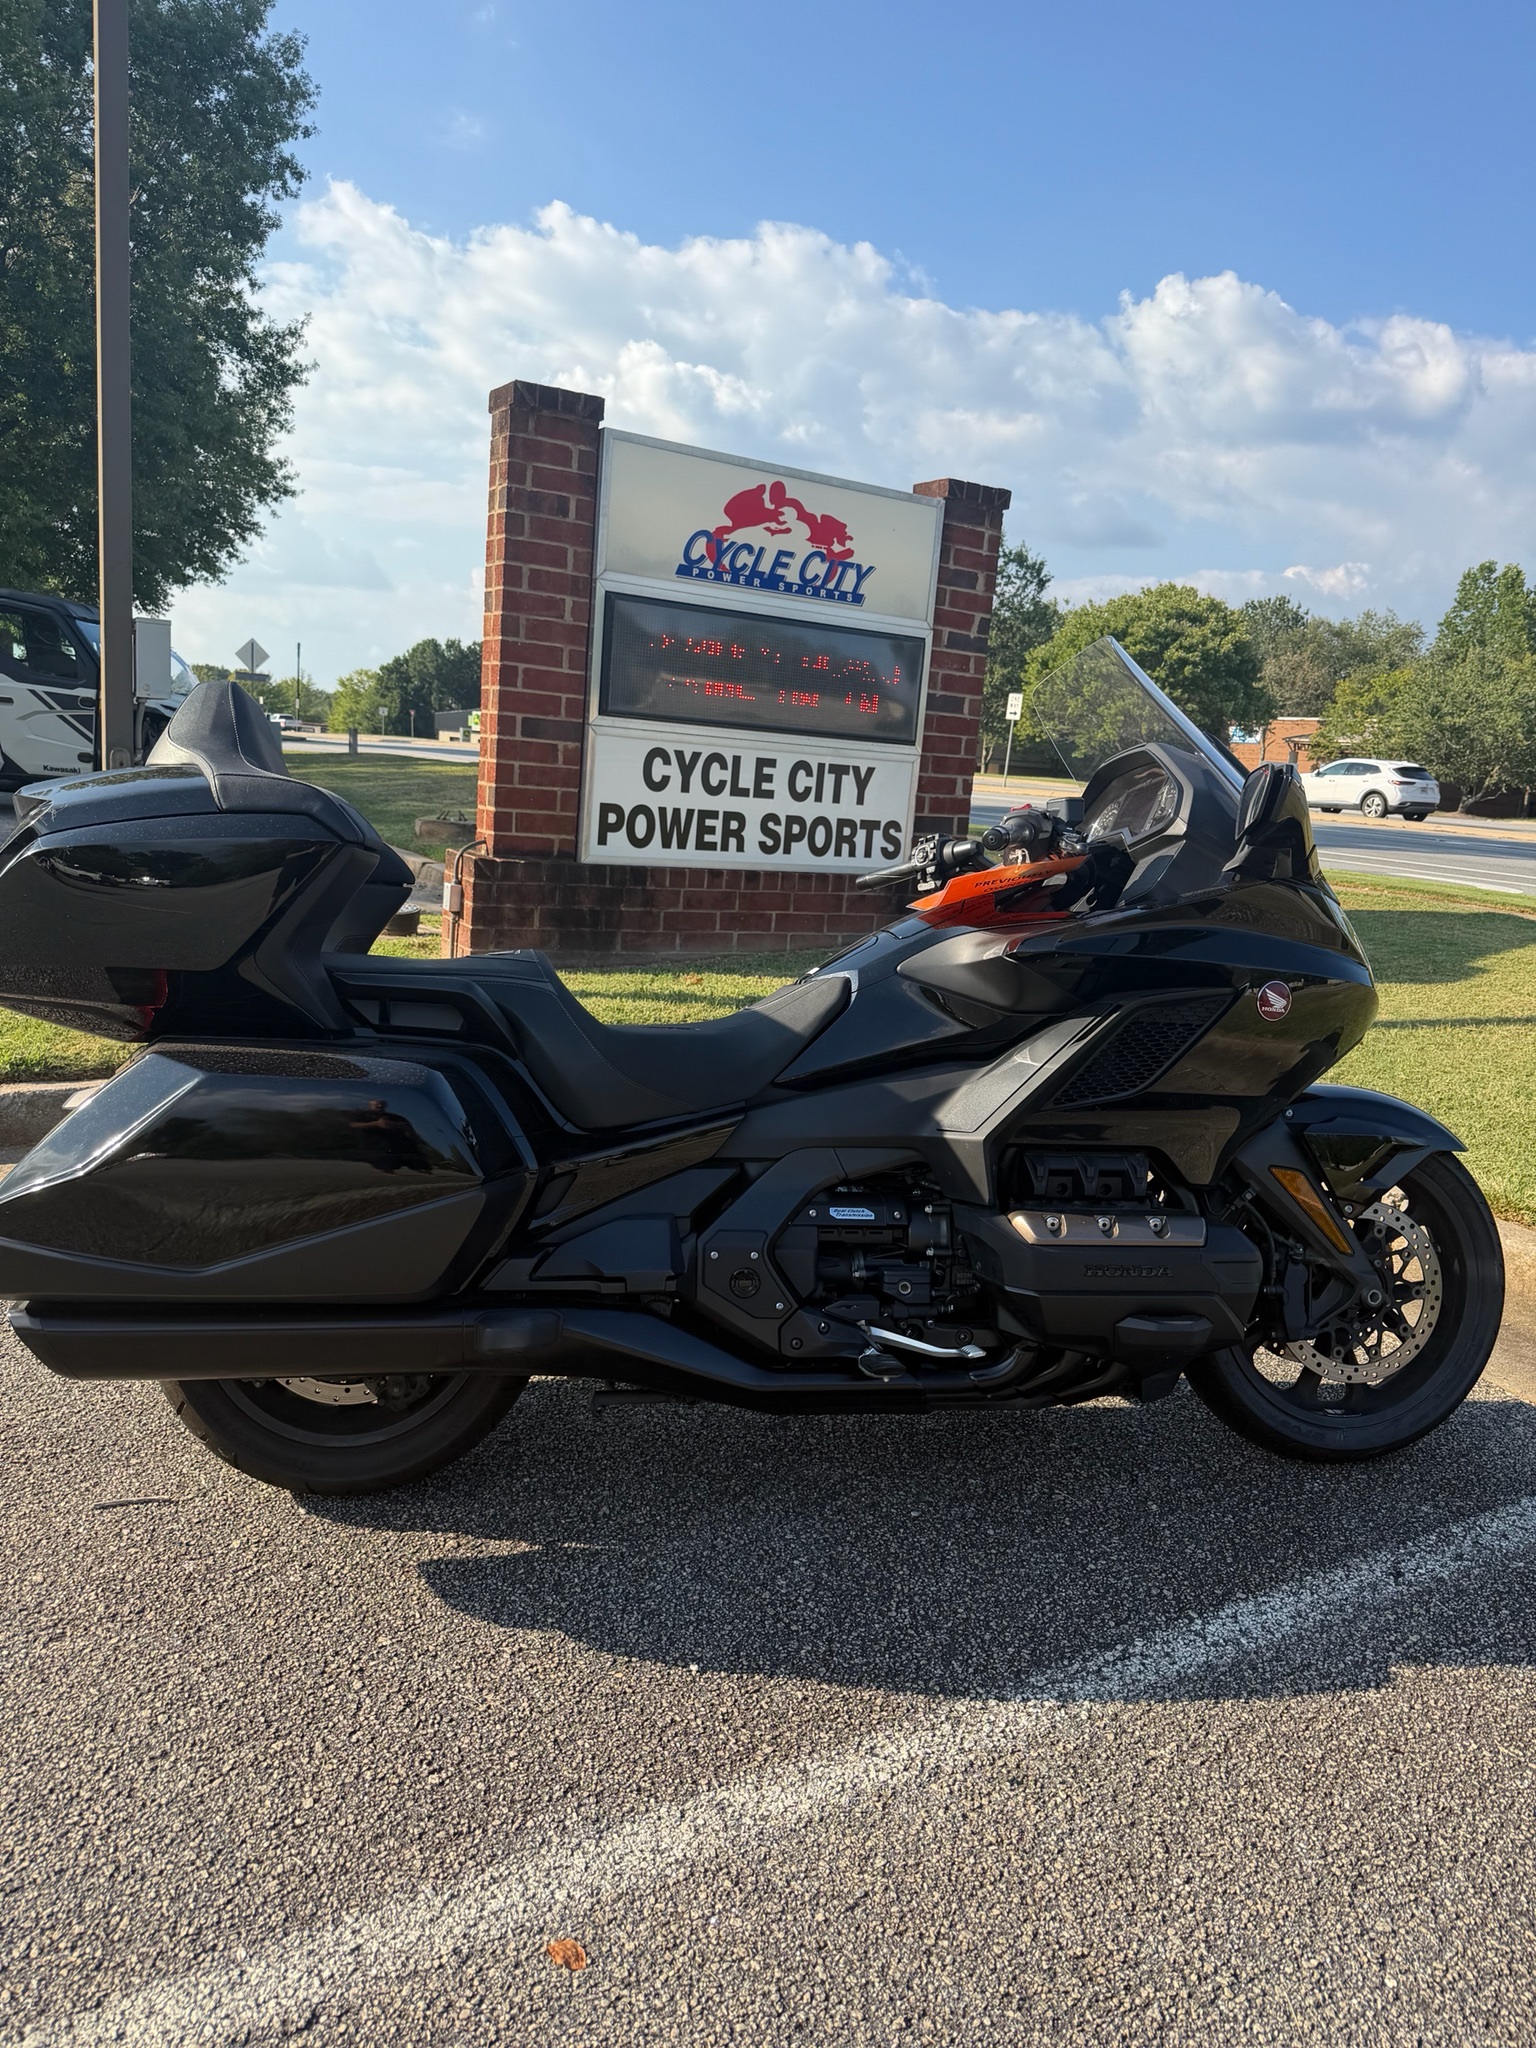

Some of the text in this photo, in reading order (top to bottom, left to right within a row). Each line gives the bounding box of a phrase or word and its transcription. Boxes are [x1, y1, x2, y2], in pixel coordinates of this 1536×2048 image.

[683, 529, 877, 594] CYCLE CITY
[692, 567, 853, 602] POWER SPORTS
[43, 765, 81, 774] Kawasaki
[642, 746, 876, 806] CYCLE CITY
[597, 802, 903, 861] POWER SPORTS
[1084, 1264, 1175, 1278] HONDA
